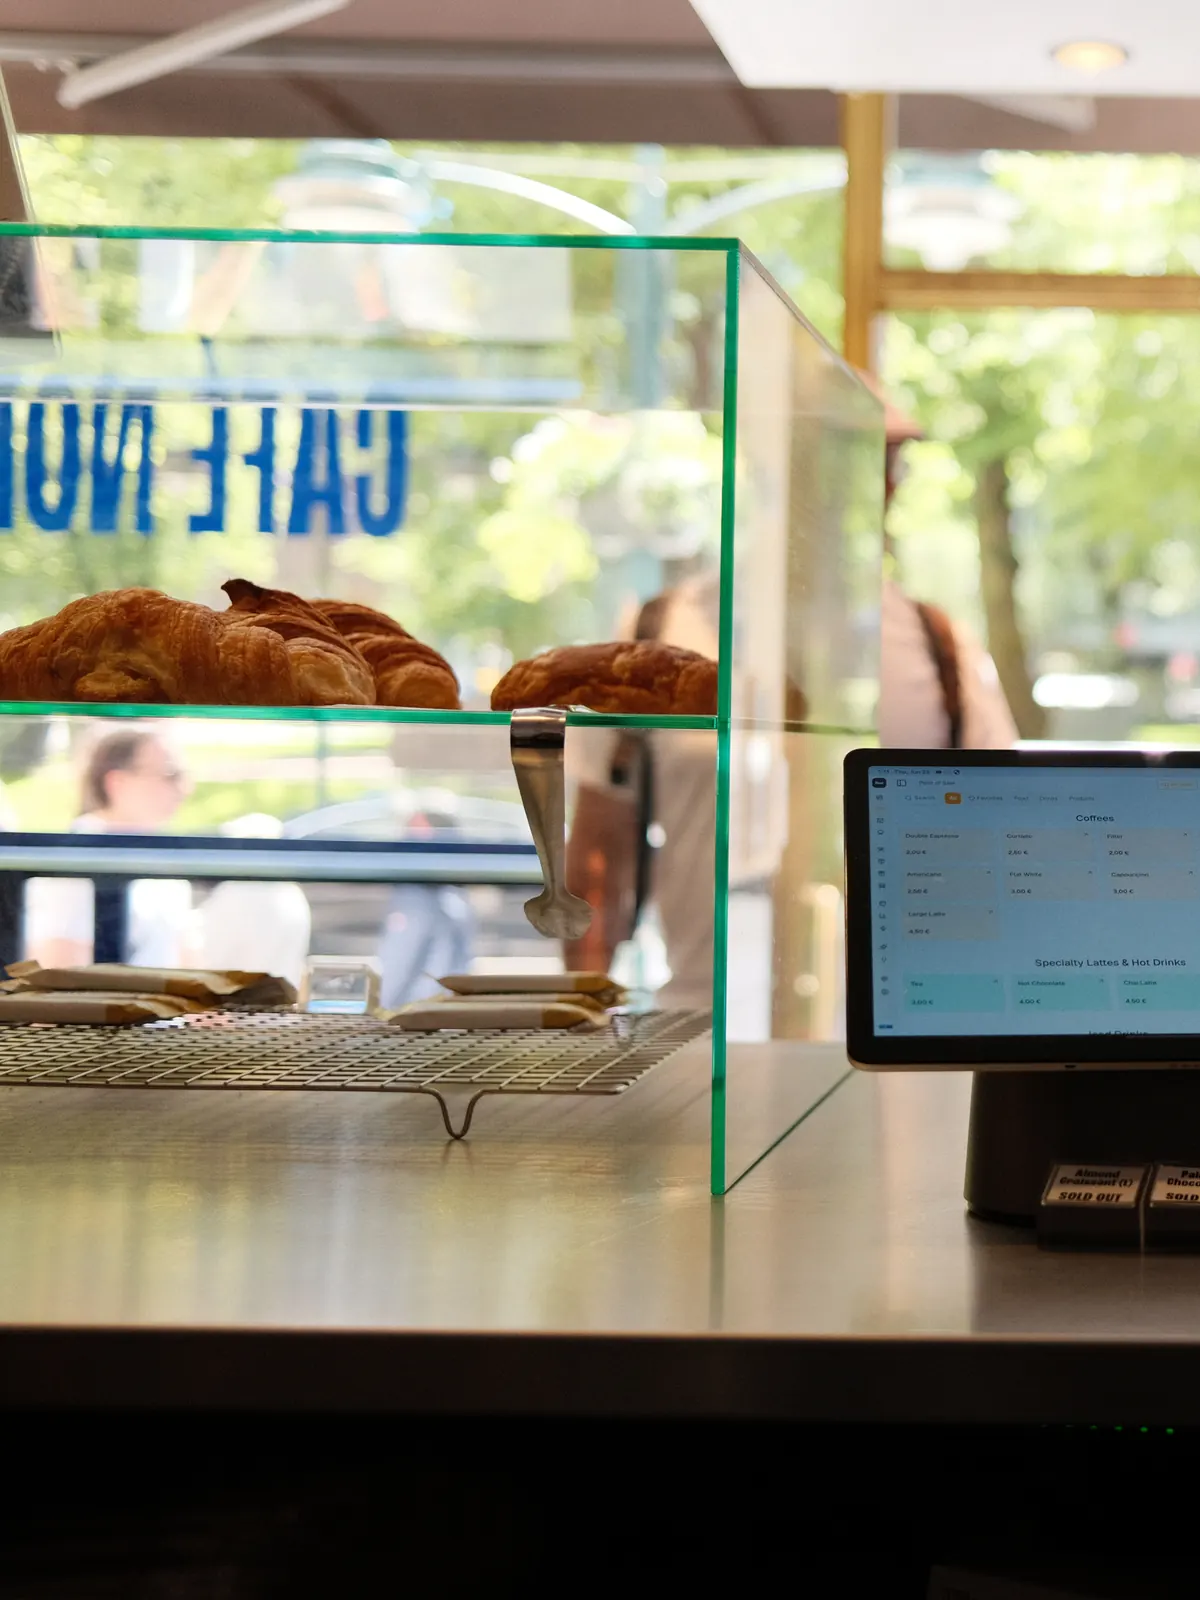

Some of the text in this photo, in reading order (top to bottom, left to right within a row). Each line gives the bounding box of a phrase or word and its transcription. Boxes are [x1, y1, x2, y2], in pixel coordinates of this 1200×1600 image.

[1075, 814, 1115, 822] Coffees
[1035, 958, 1186, 968] Specialty Lattes & Hot Drinks
[1074, 1169, 1121, 1179] Almond
[1058, 1191, 1124, 1202] SOLD OUT
[1165, 1192, 1199, 1201] SOLD
